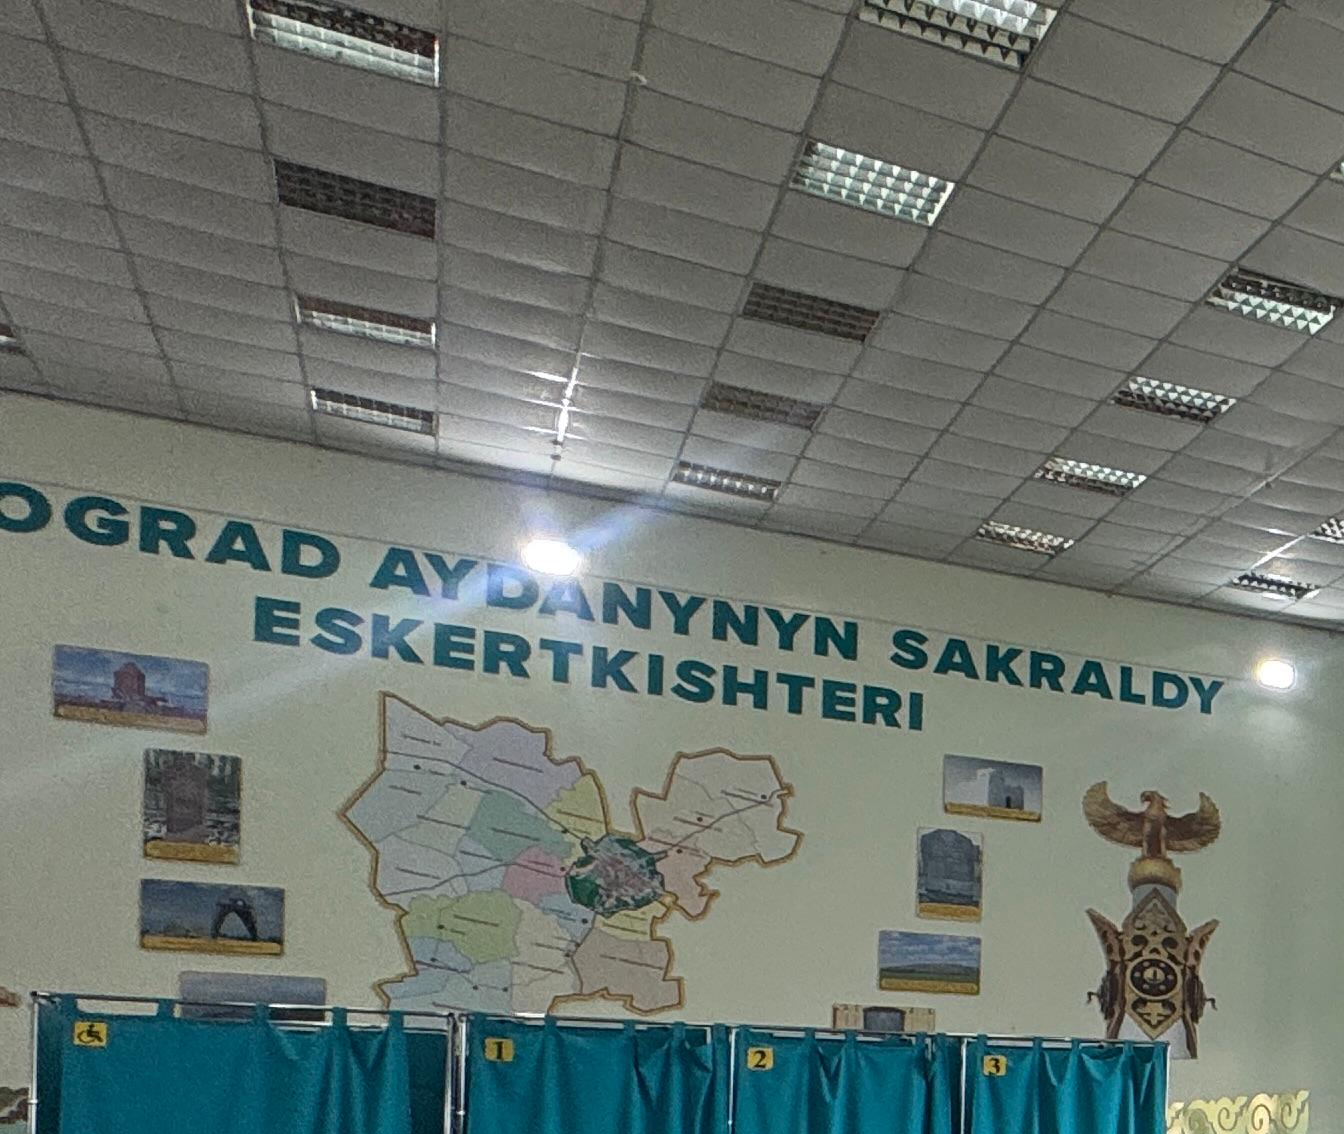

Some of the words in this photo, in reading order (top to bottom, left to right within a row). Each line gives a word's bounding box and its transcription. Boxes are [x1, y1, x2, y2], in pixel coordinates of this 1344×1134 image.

[0, 481, 340, 579] OGRAD
[369, 546, 859, 661] AYDANYNYN
[889, 629, 1225, 715] SAKRALDY
[253, 595, 925, 731] ESKERTKISHTERI
[753, 1050, 767, 1069] 2
[989, 1057, 1001, 1075] 3
